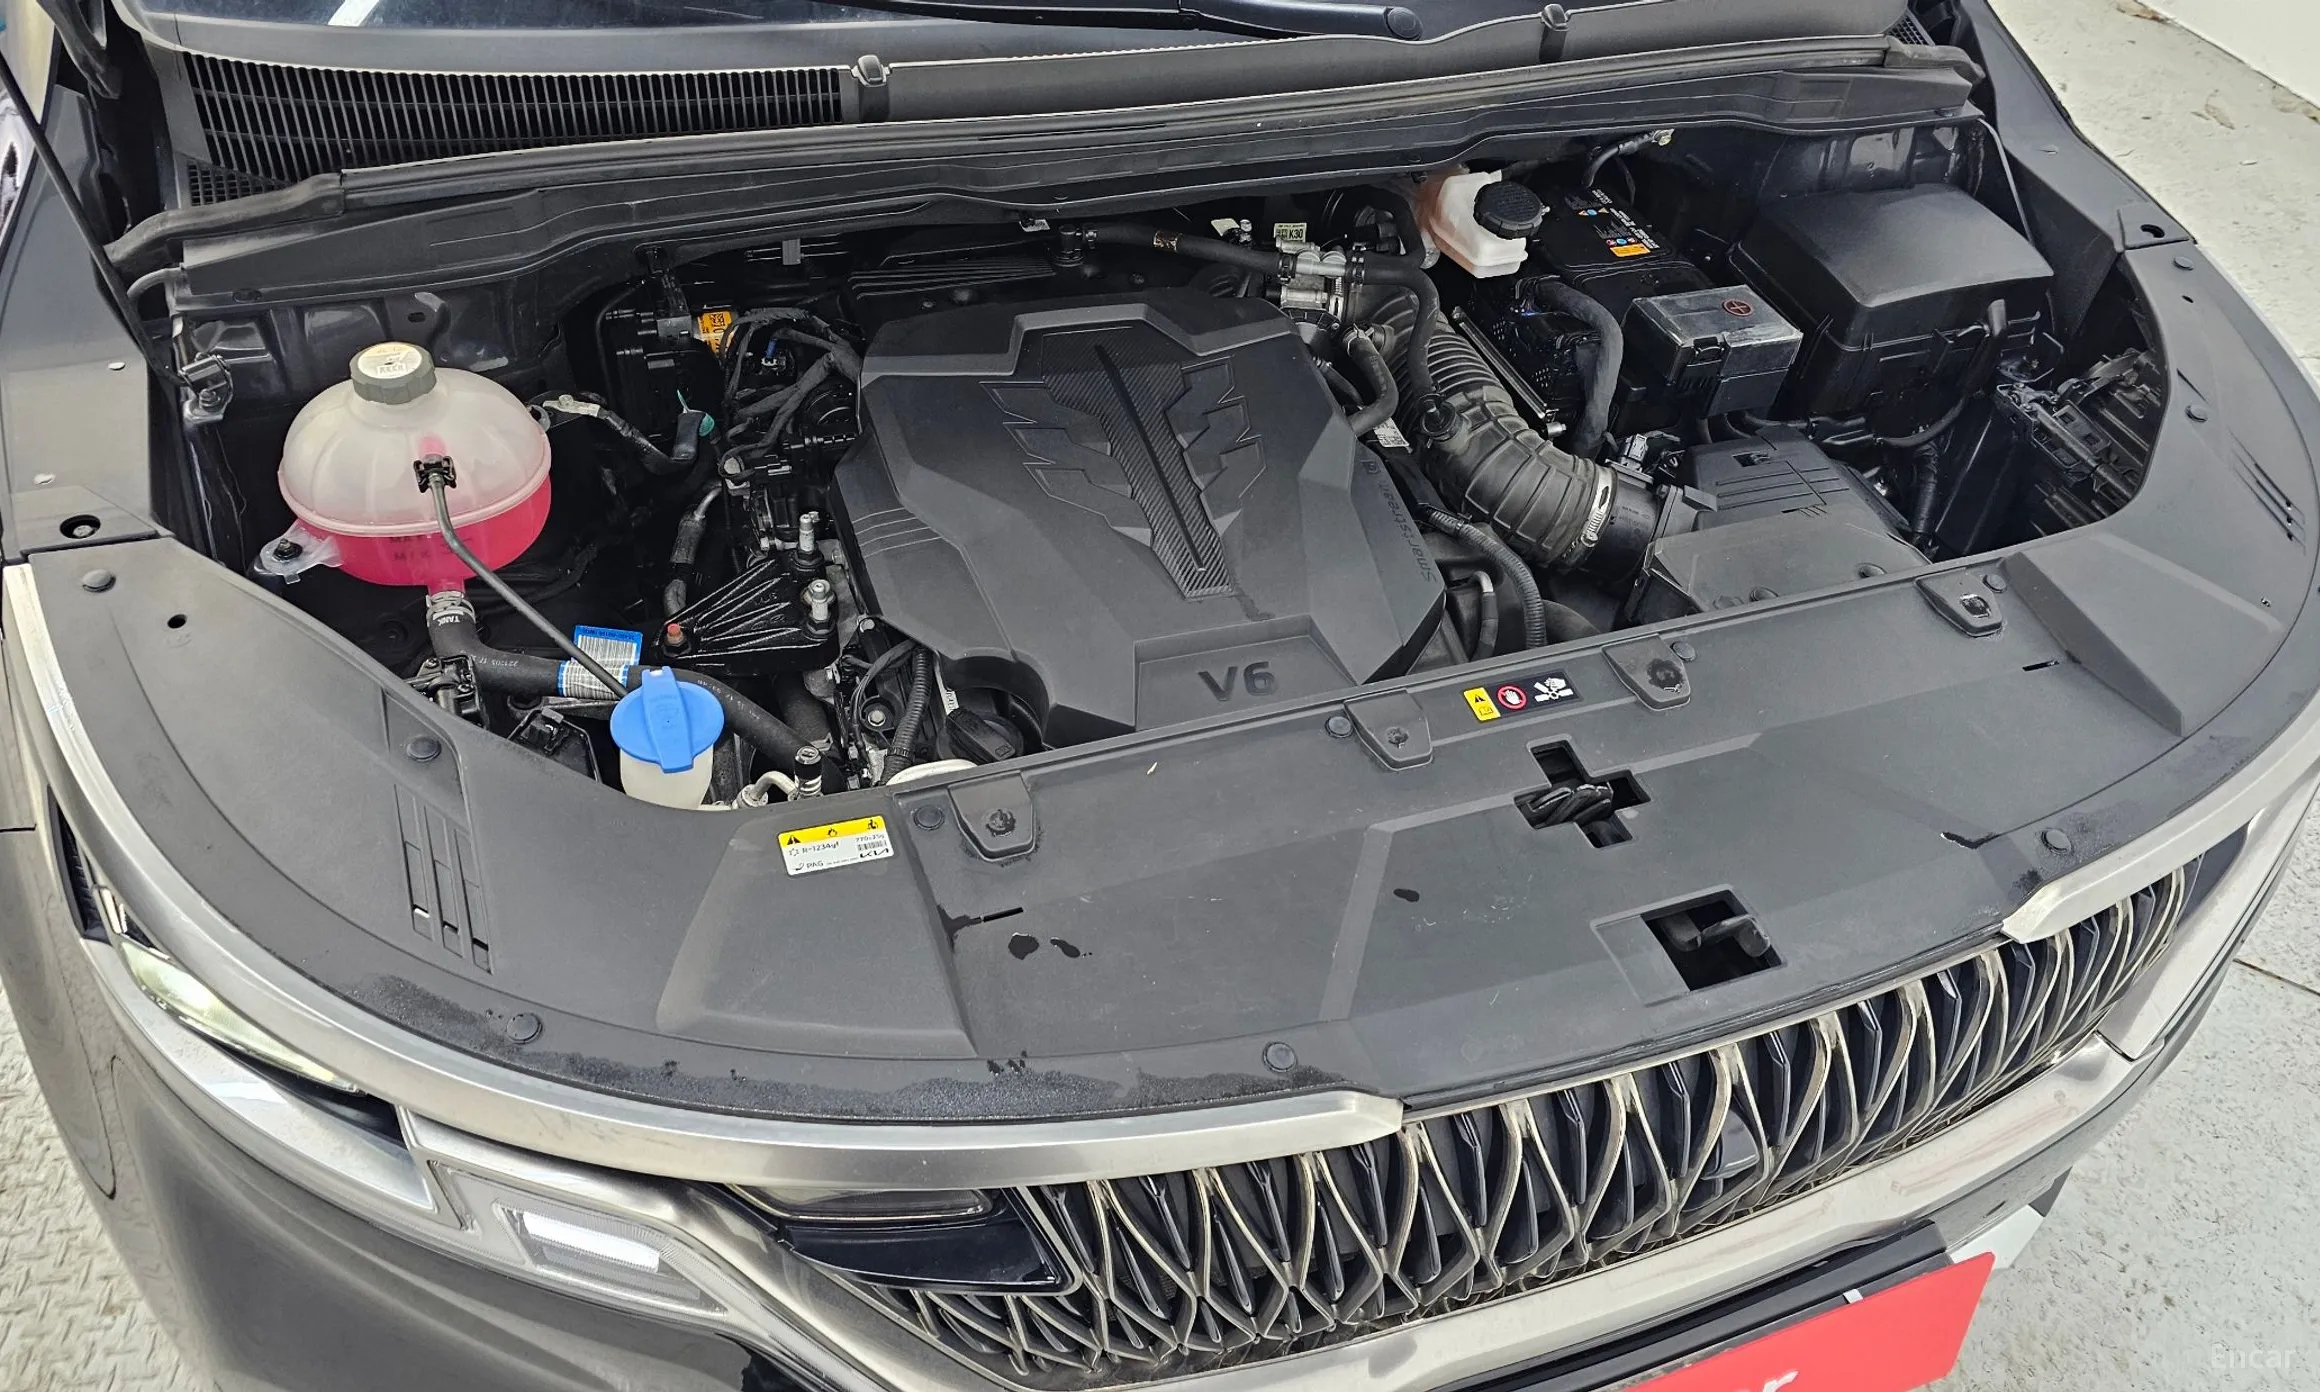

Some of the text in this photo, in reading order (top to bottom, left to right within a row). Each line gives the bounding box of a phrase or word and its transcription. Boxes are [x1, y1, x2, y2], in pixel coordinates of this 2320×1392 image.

[1378, 481, 1437, 582] Smartstream
[438, 615, 461, 627] TANK
[1197, 661, 1278, 702] V6
[802, 840, 840, 855] R-1234yf
[860, 847, 890, 859] KIA
[806, 859, 825, 869] PAG
